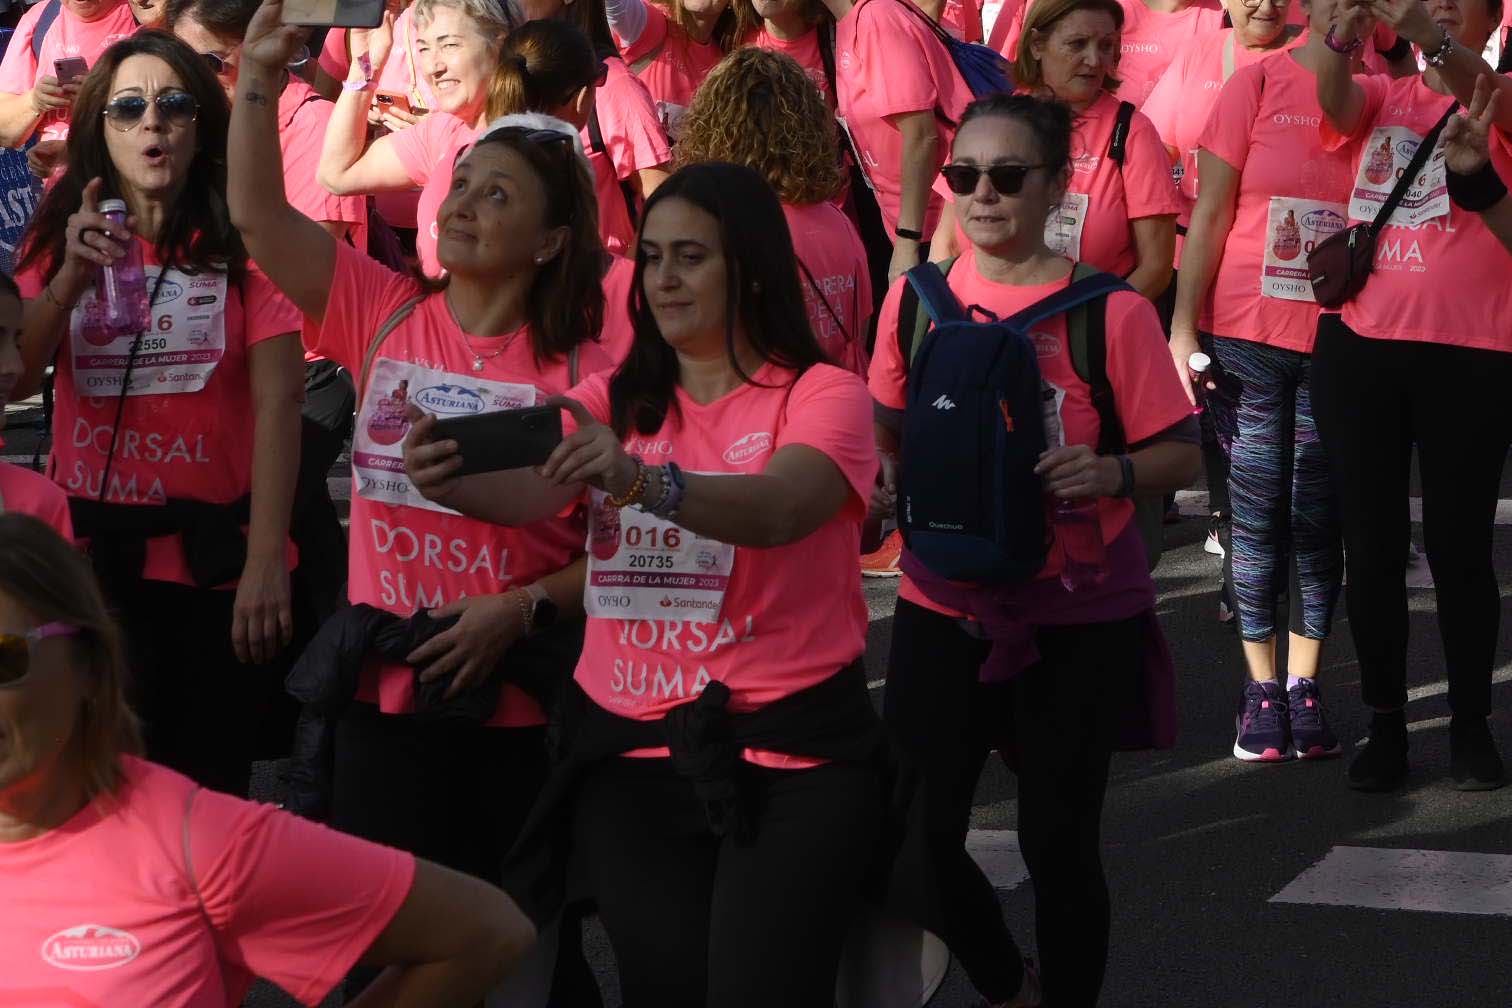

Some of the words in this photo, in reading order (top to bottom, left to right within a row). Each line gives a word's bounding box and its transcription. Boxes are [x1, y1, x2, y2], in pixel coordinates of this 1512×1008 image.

[1273, 112, 1321, 128] OYSHO
[421, 394, 479, 412] ASTURIANA
[72, 417, 211, 465] DORSAL
[66, 459, 168, 505] SUMA
[625, 526, 681, 548] 016
[371, 518, 513, 580] DORSAL
[628, 554, 674, 569] 20735
[633, 575, 646, 584] DE
[648, 576, 661, 585] LA
[663, 577, 697, 586] MUJER
[610, 658, 716, 699] SUMA
